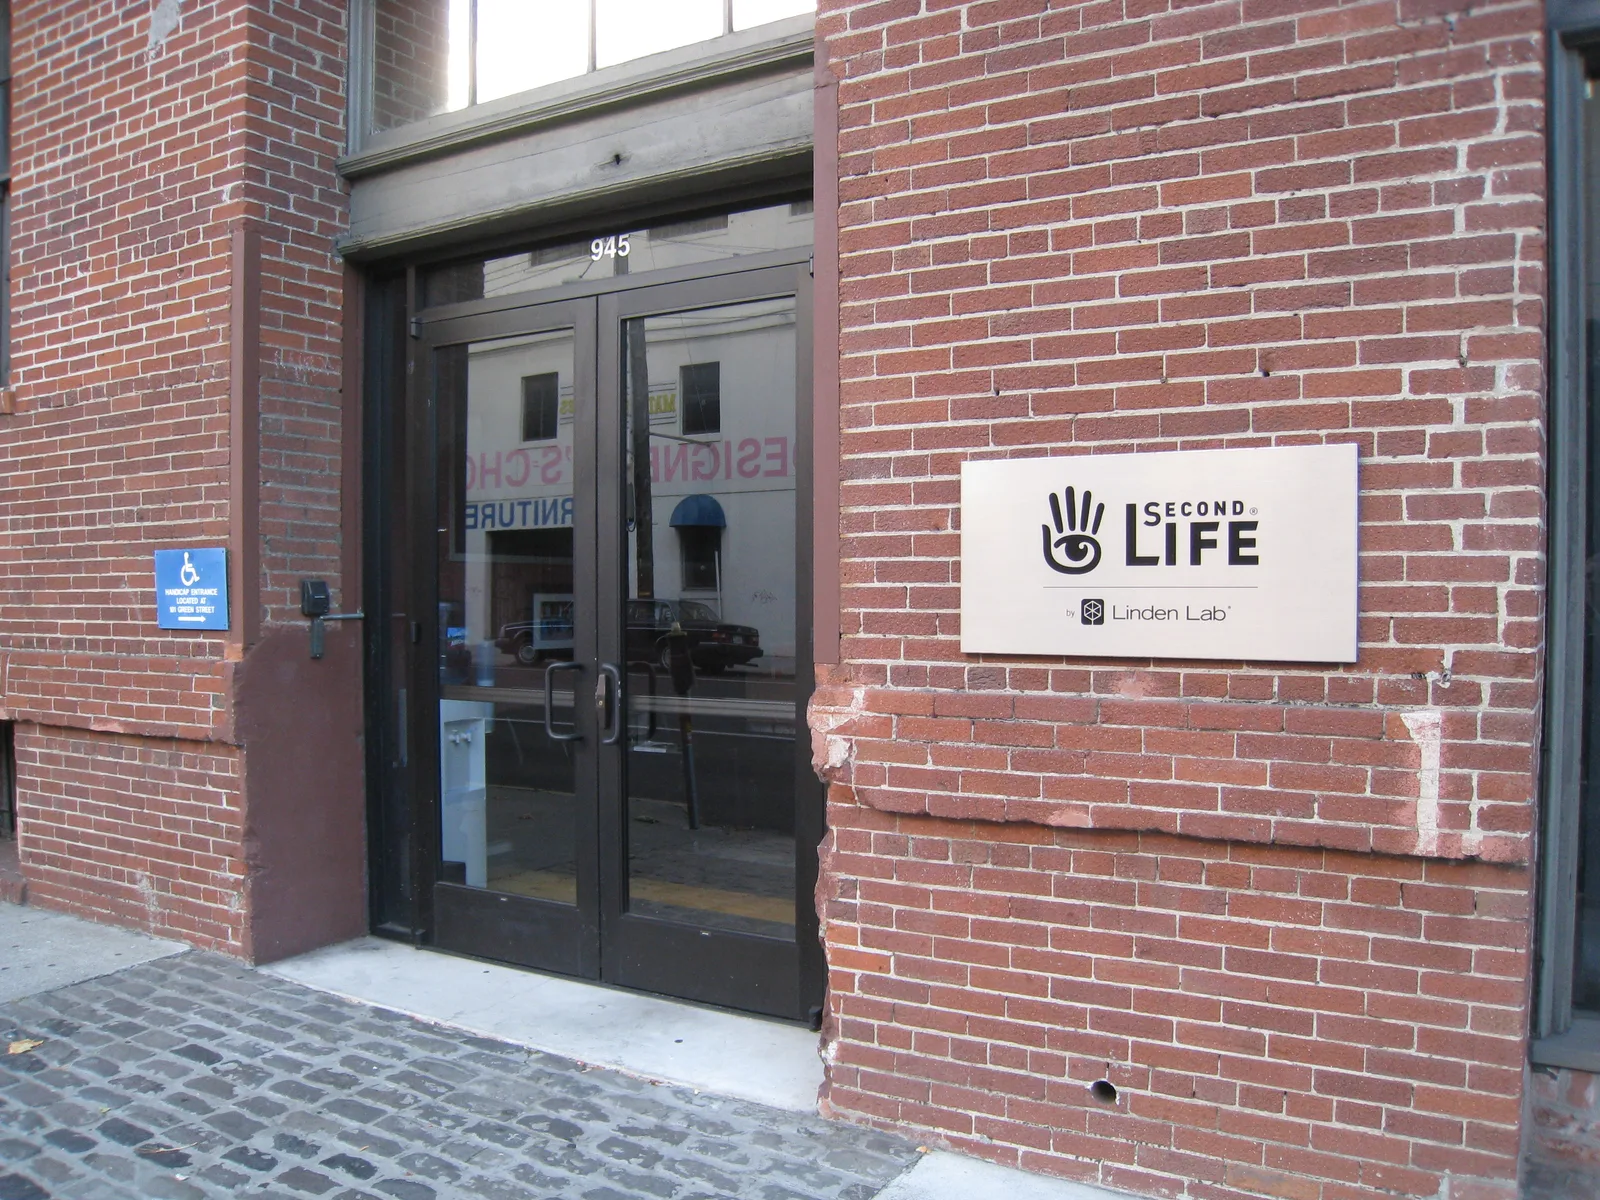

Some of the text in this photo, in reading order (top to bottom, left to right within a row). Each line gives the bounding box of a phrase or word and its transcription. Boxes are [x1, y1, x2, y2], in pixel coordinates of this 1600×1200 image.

[590, 234, 631, 261] 945
[1143, 500, 1245, 527] SECOND
[1125, 503, 1259, 566] LIFE
[1066, 604, 1227, 621] by Linden Lab
